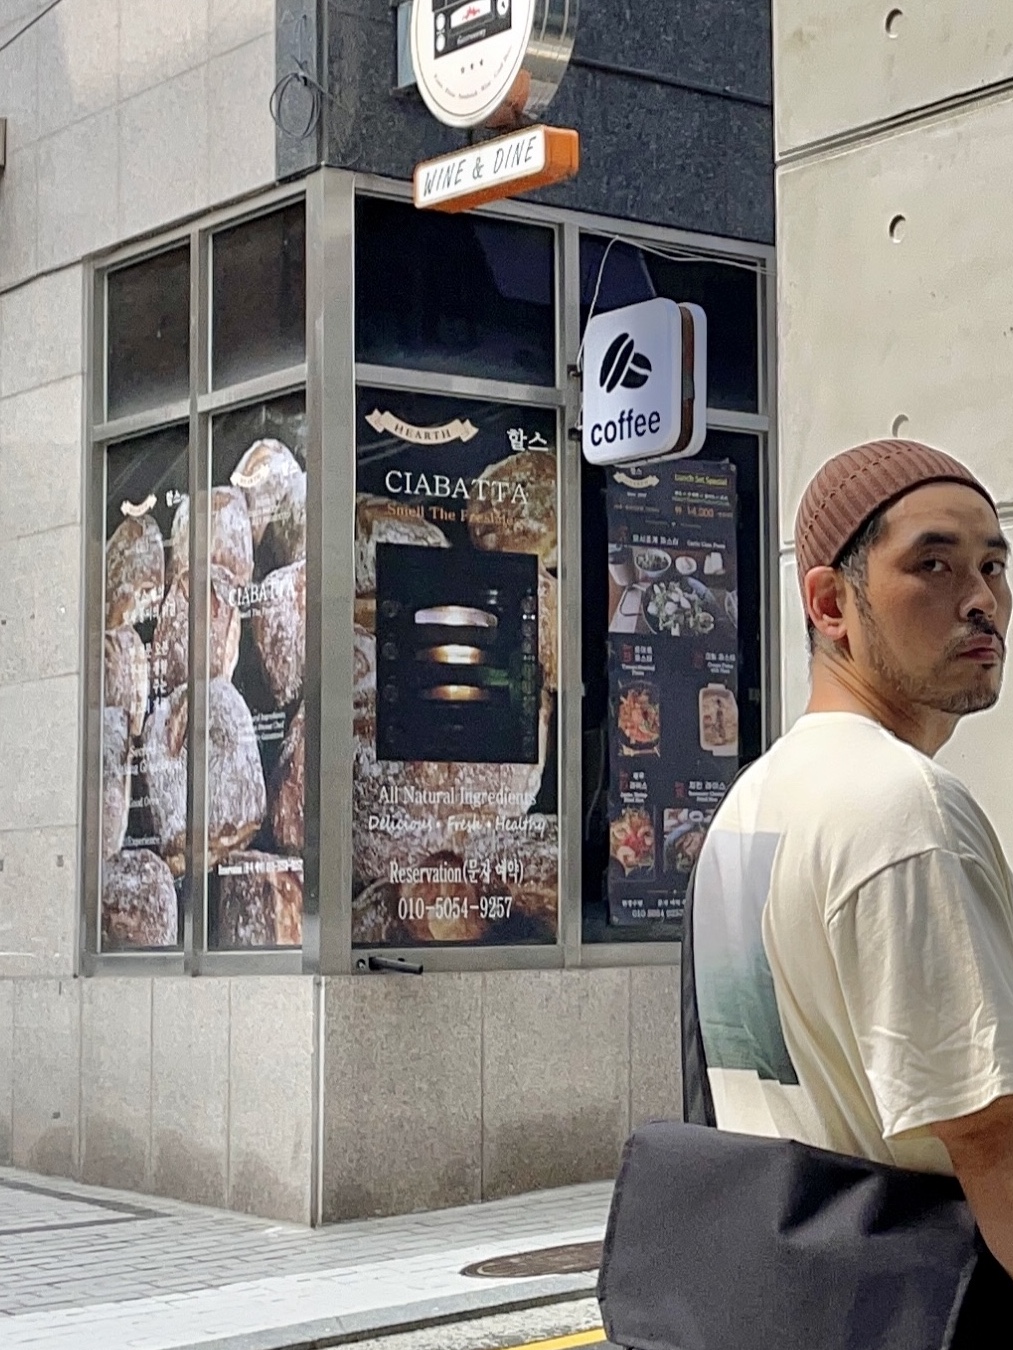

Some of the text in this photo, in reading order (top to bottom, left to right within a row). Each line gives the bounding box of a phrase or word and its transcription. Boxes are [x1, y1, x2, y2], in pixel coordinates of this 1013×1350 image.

[423, 135, 537, 197] WINE & DINE
[394, 423, 452, 440] HEARTH
[590, 408, 661, 446] coffee
[385, 470, 528, 505] CIABATTA
[387, 503, 425, 519] Smell
[429, 506, 456, 521] The
[378, 785, 537, 810] All Natural Ingredients
[368, 813, 546, 838] Delicious Fresh Healthy
